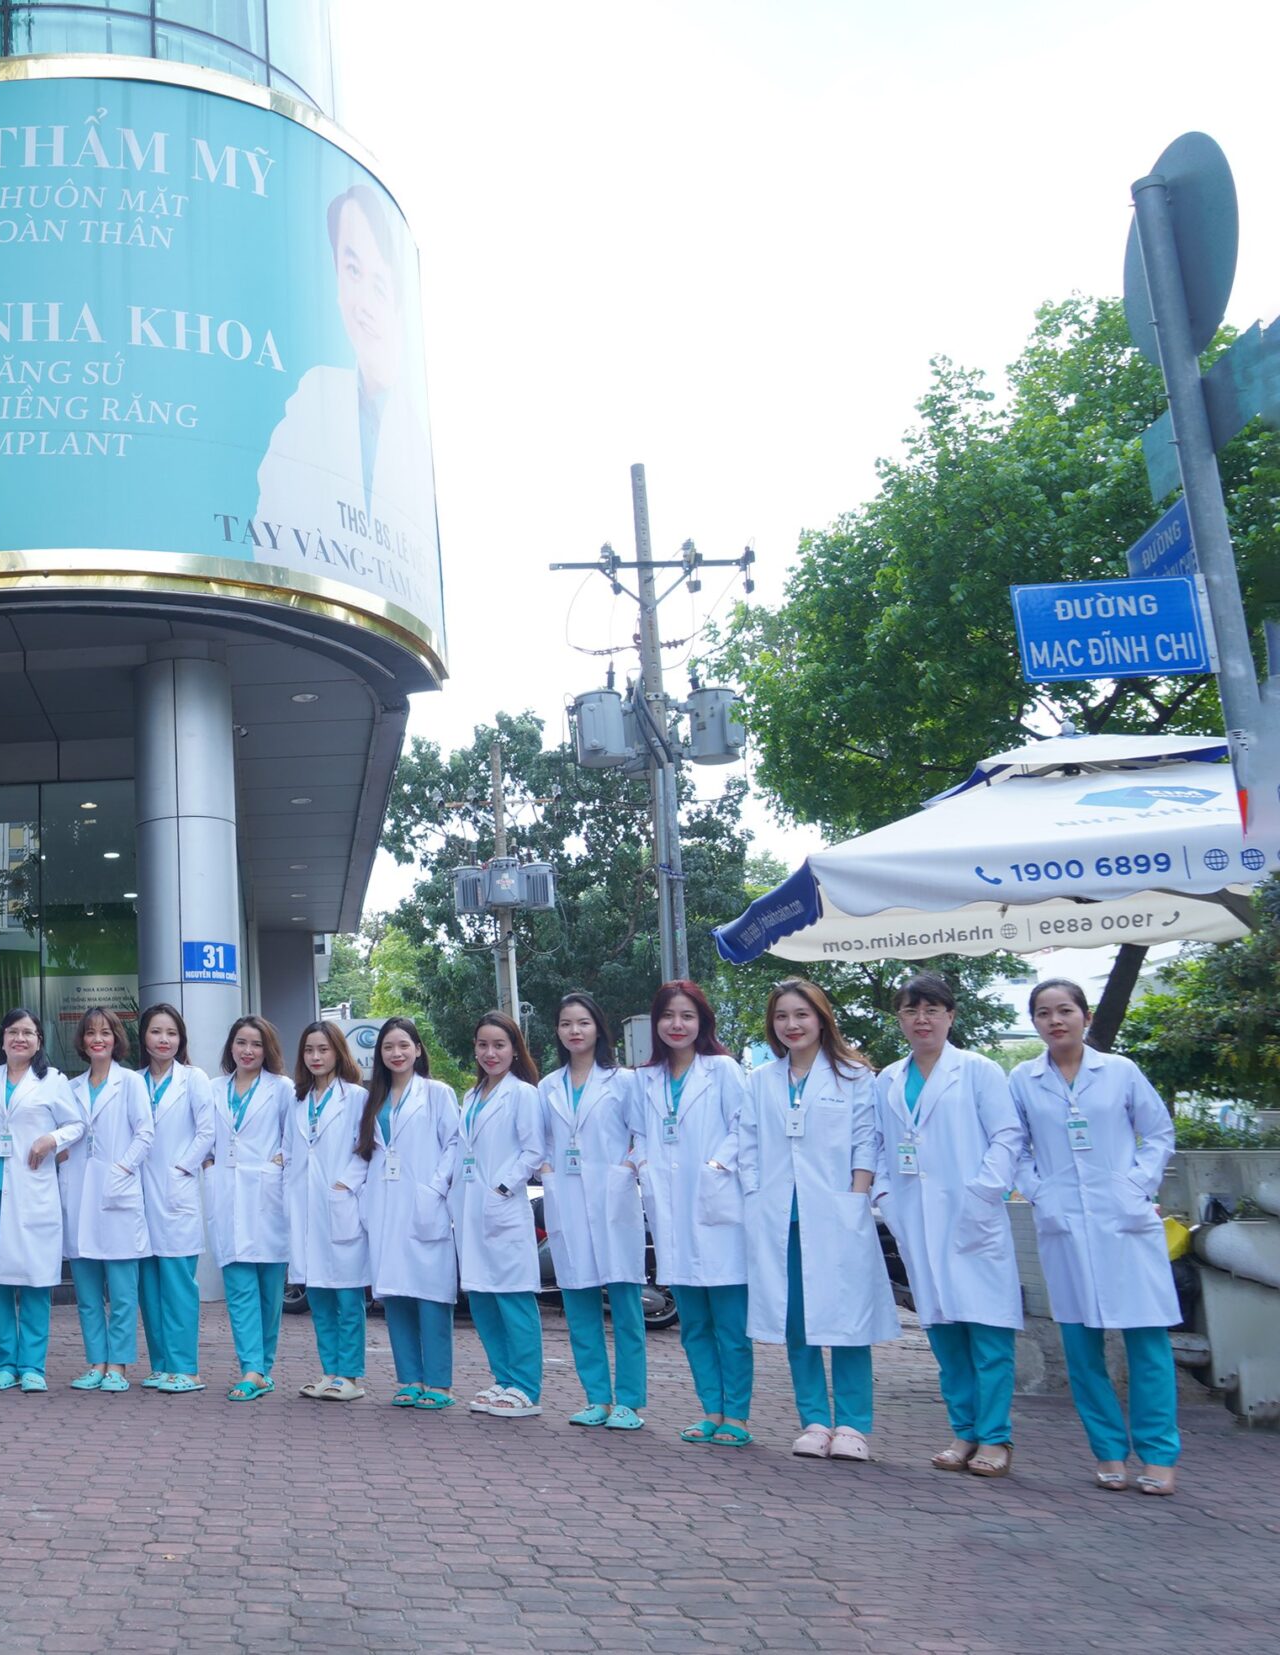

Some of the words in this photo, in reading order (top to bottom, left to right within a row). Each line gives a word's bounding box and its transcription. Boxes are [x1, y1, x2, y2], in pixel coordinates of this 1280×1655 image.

[191, 134, 277, 199] MỸ
[117, 185, 190, 219] MẶT
[79, 215, 175, 249] THÂN
[126, 304, 287, 374] KHOA
[82, 351, 126, 386] SỨ
[99, 392, 199, 428] RĂNG
[213, 513, 283, 551] TAY
[336, 500, 372, 541] THS.
[1053, 592, 1159, 622] ĐƯỜNG
[1029, 638, 1085, 674] MẠC
[1087, 630, 1150, 666] ĐĨNH
[1154, 631, 1198, 662] CHI
[1010, 859, 1085, 882] 1900
[1095, 852, 1171, 877] 6899
[203, 944, 224, 969] 31
